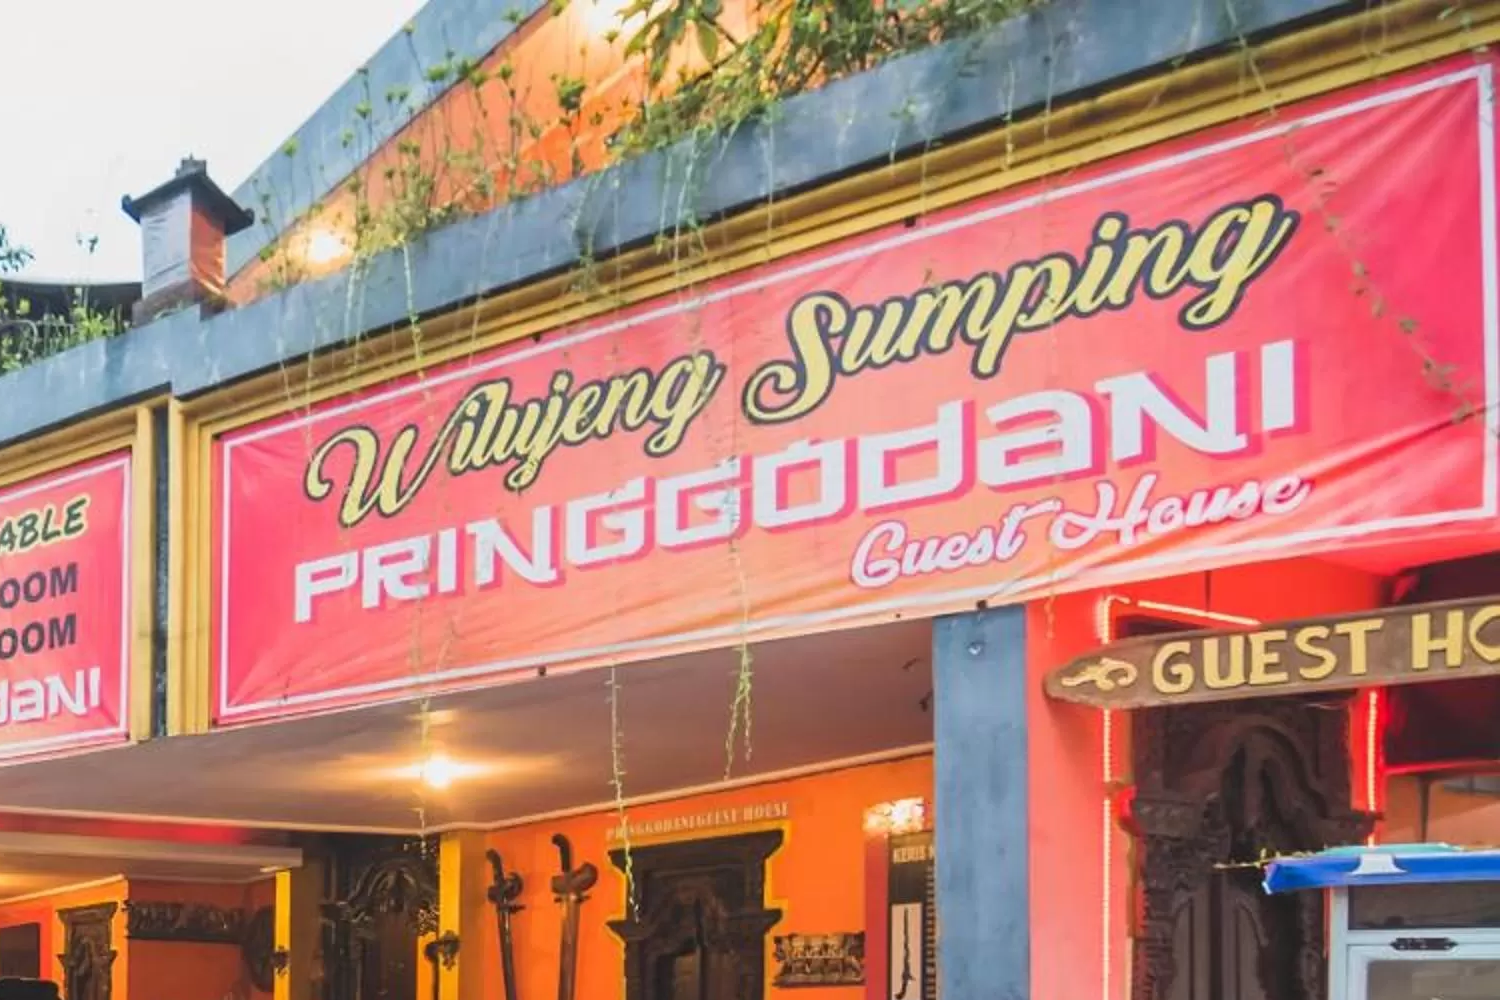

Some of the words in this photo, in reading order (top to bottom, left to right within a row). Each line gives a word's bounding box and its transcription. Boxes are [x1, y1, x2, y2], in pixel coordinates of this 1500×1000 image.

[304, 349, 728, 529] Wilujeng
[741, 193, 1300, 425] Sumping
[850, 498, 1060, 589] Guest
[1048, 474, 1314, 550] House
[1152, 618, 1385, 694] GUEST
